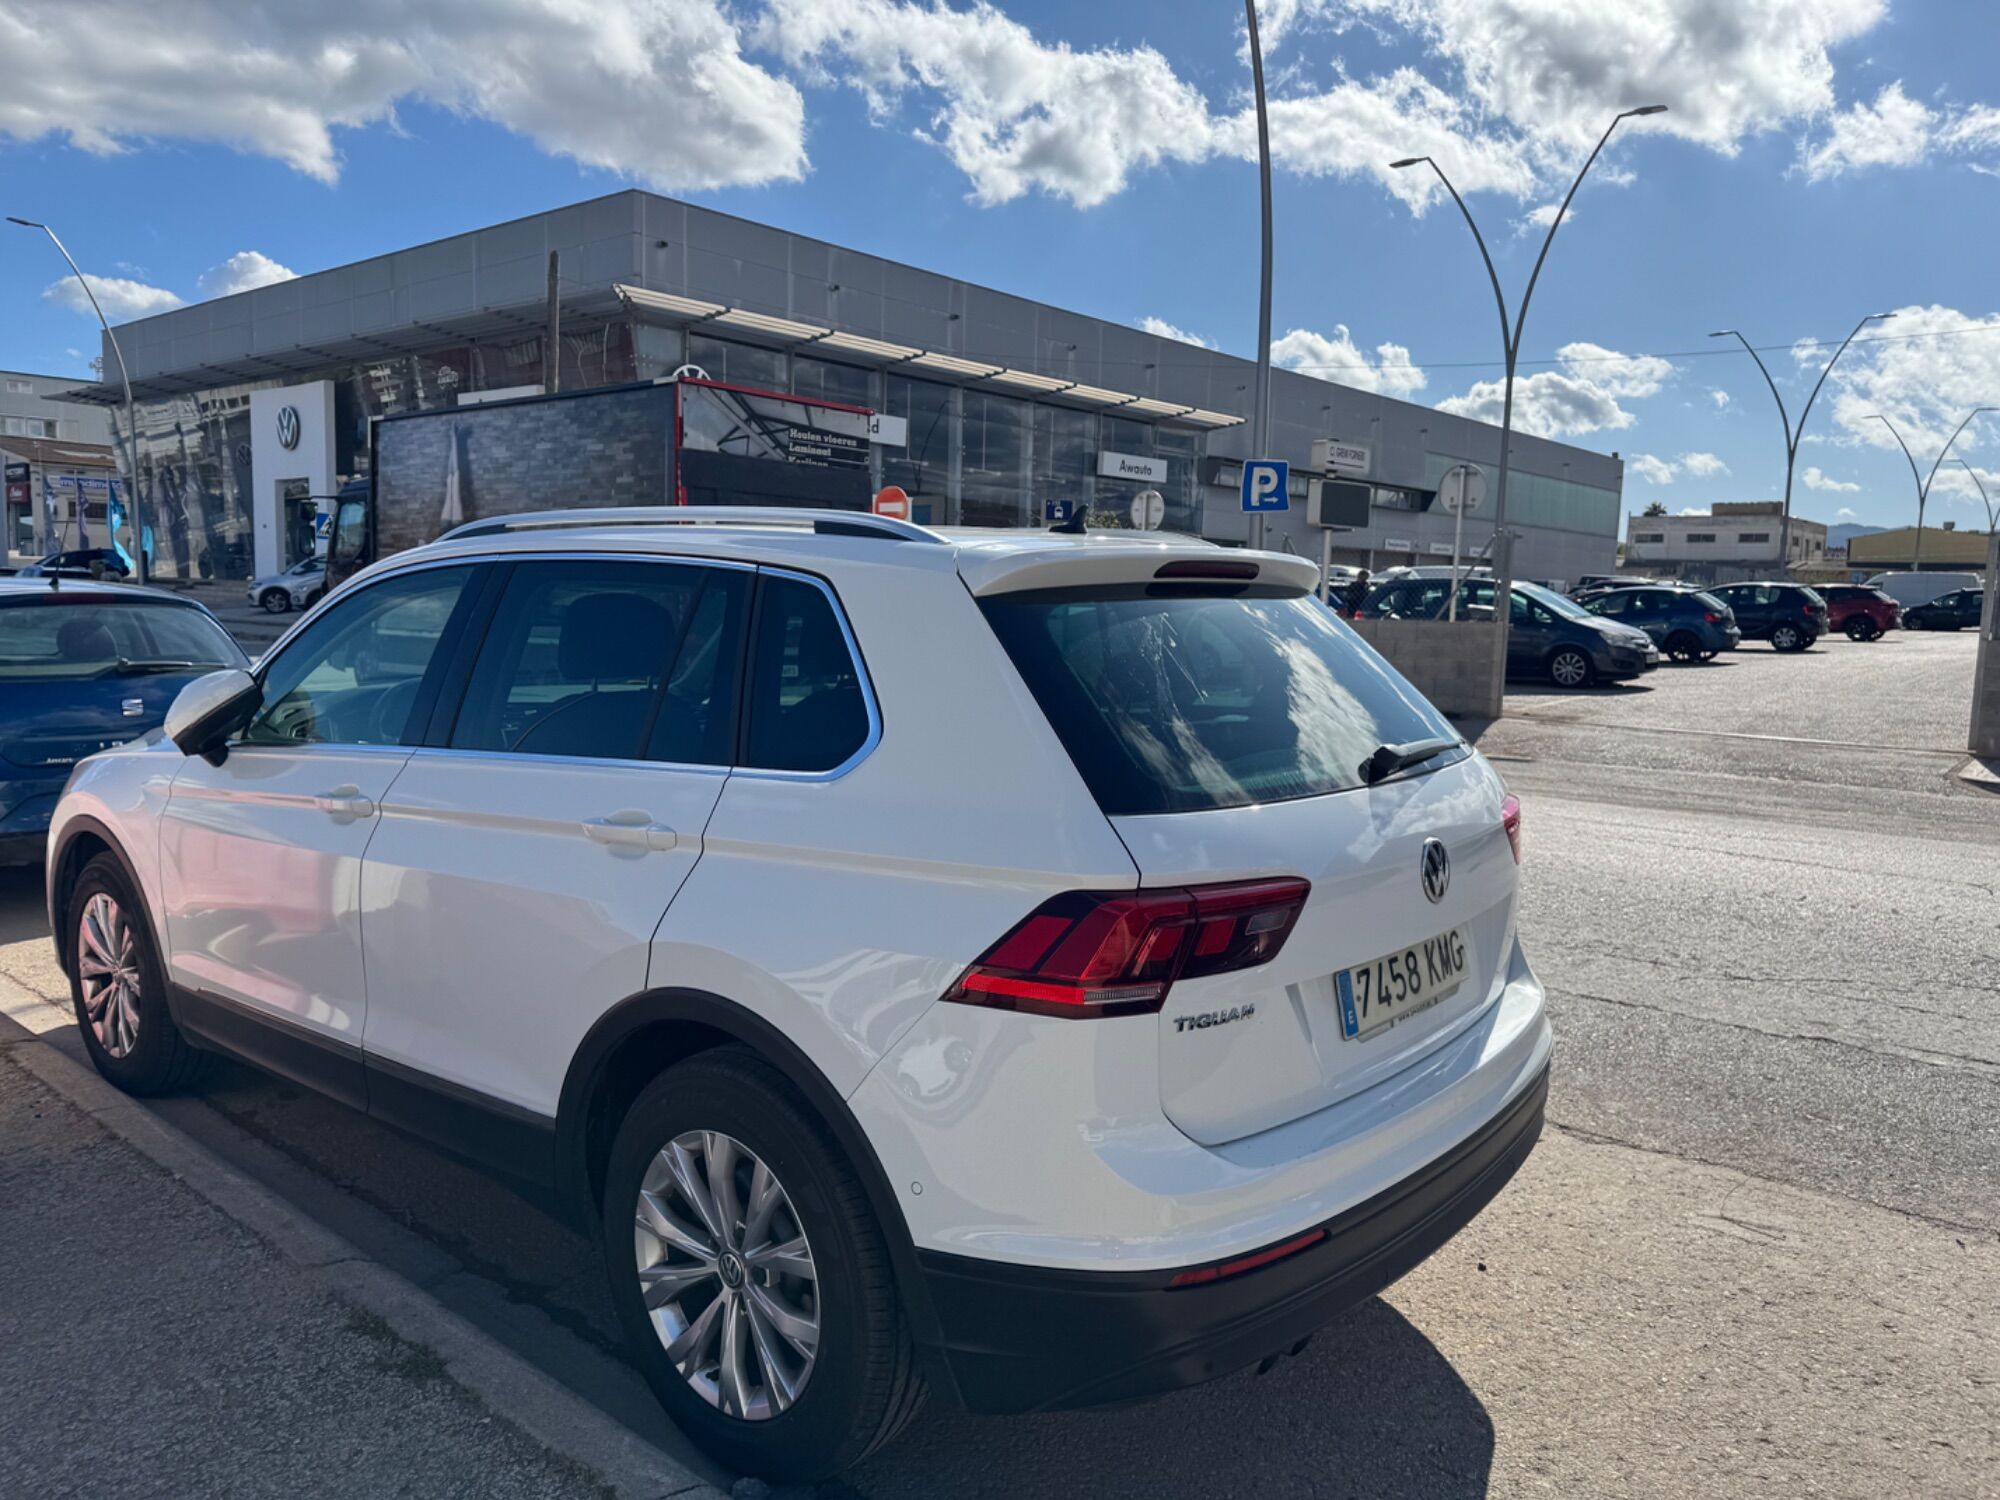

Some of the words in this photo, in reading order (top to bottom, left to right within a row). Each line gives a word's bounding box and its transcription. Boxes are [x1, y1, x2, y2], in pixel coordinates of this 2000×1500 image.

[1119, 459, 1152, 476] Awauto
[1250, 466, 1278, 507] P
[1356, 950, 1421, 1019] 7458
[1423, 930, 1464, 987] KMG
[1173, 1003, 1255, 1032] TIGUAN
